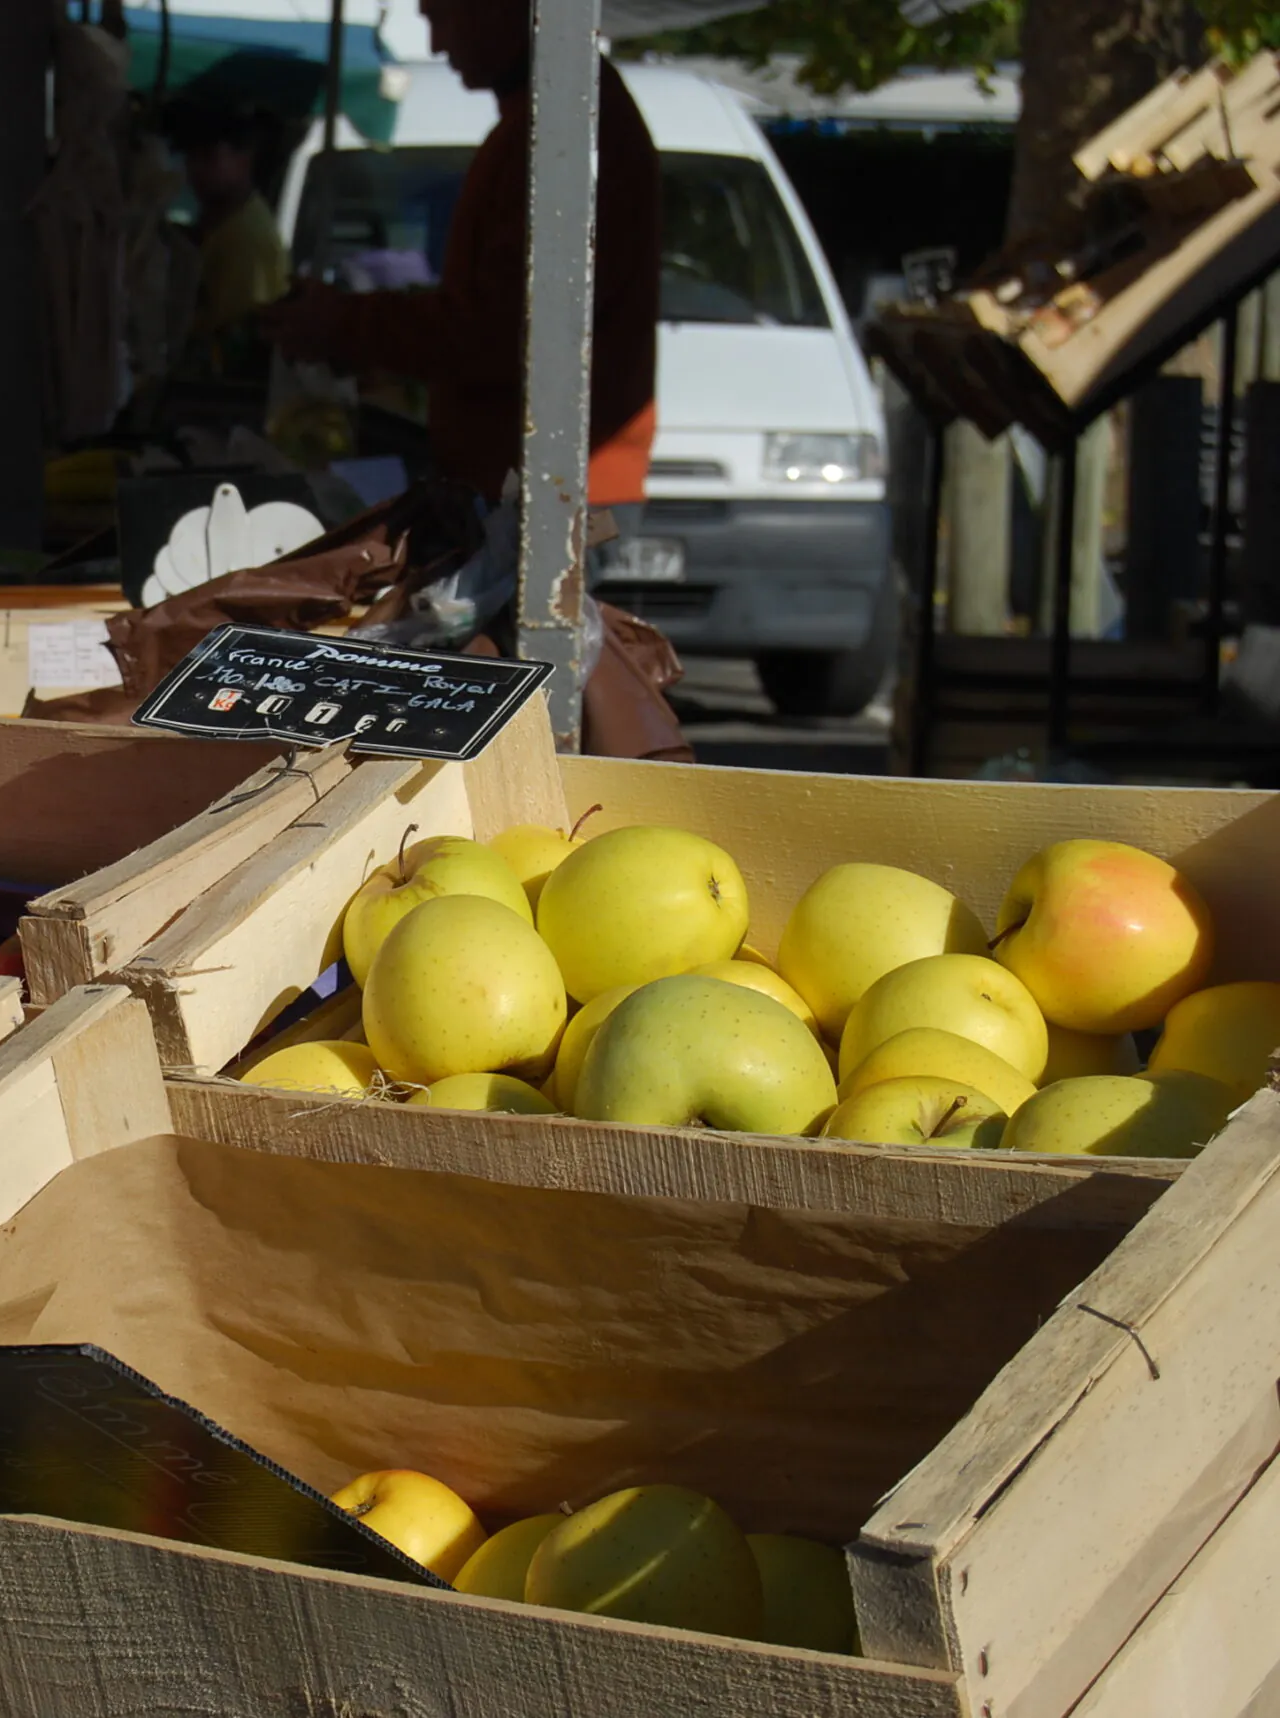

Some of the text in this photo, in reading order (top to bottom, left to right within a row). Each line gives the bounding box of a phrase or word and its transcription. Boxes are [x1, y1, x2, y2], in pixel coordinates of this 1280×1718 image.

[228, 648, 312, 671] France
[305, 643, 443, 673] Pomme
[422, 675, 498, 697] Royal
[408, 694, 477, 713] GALA
